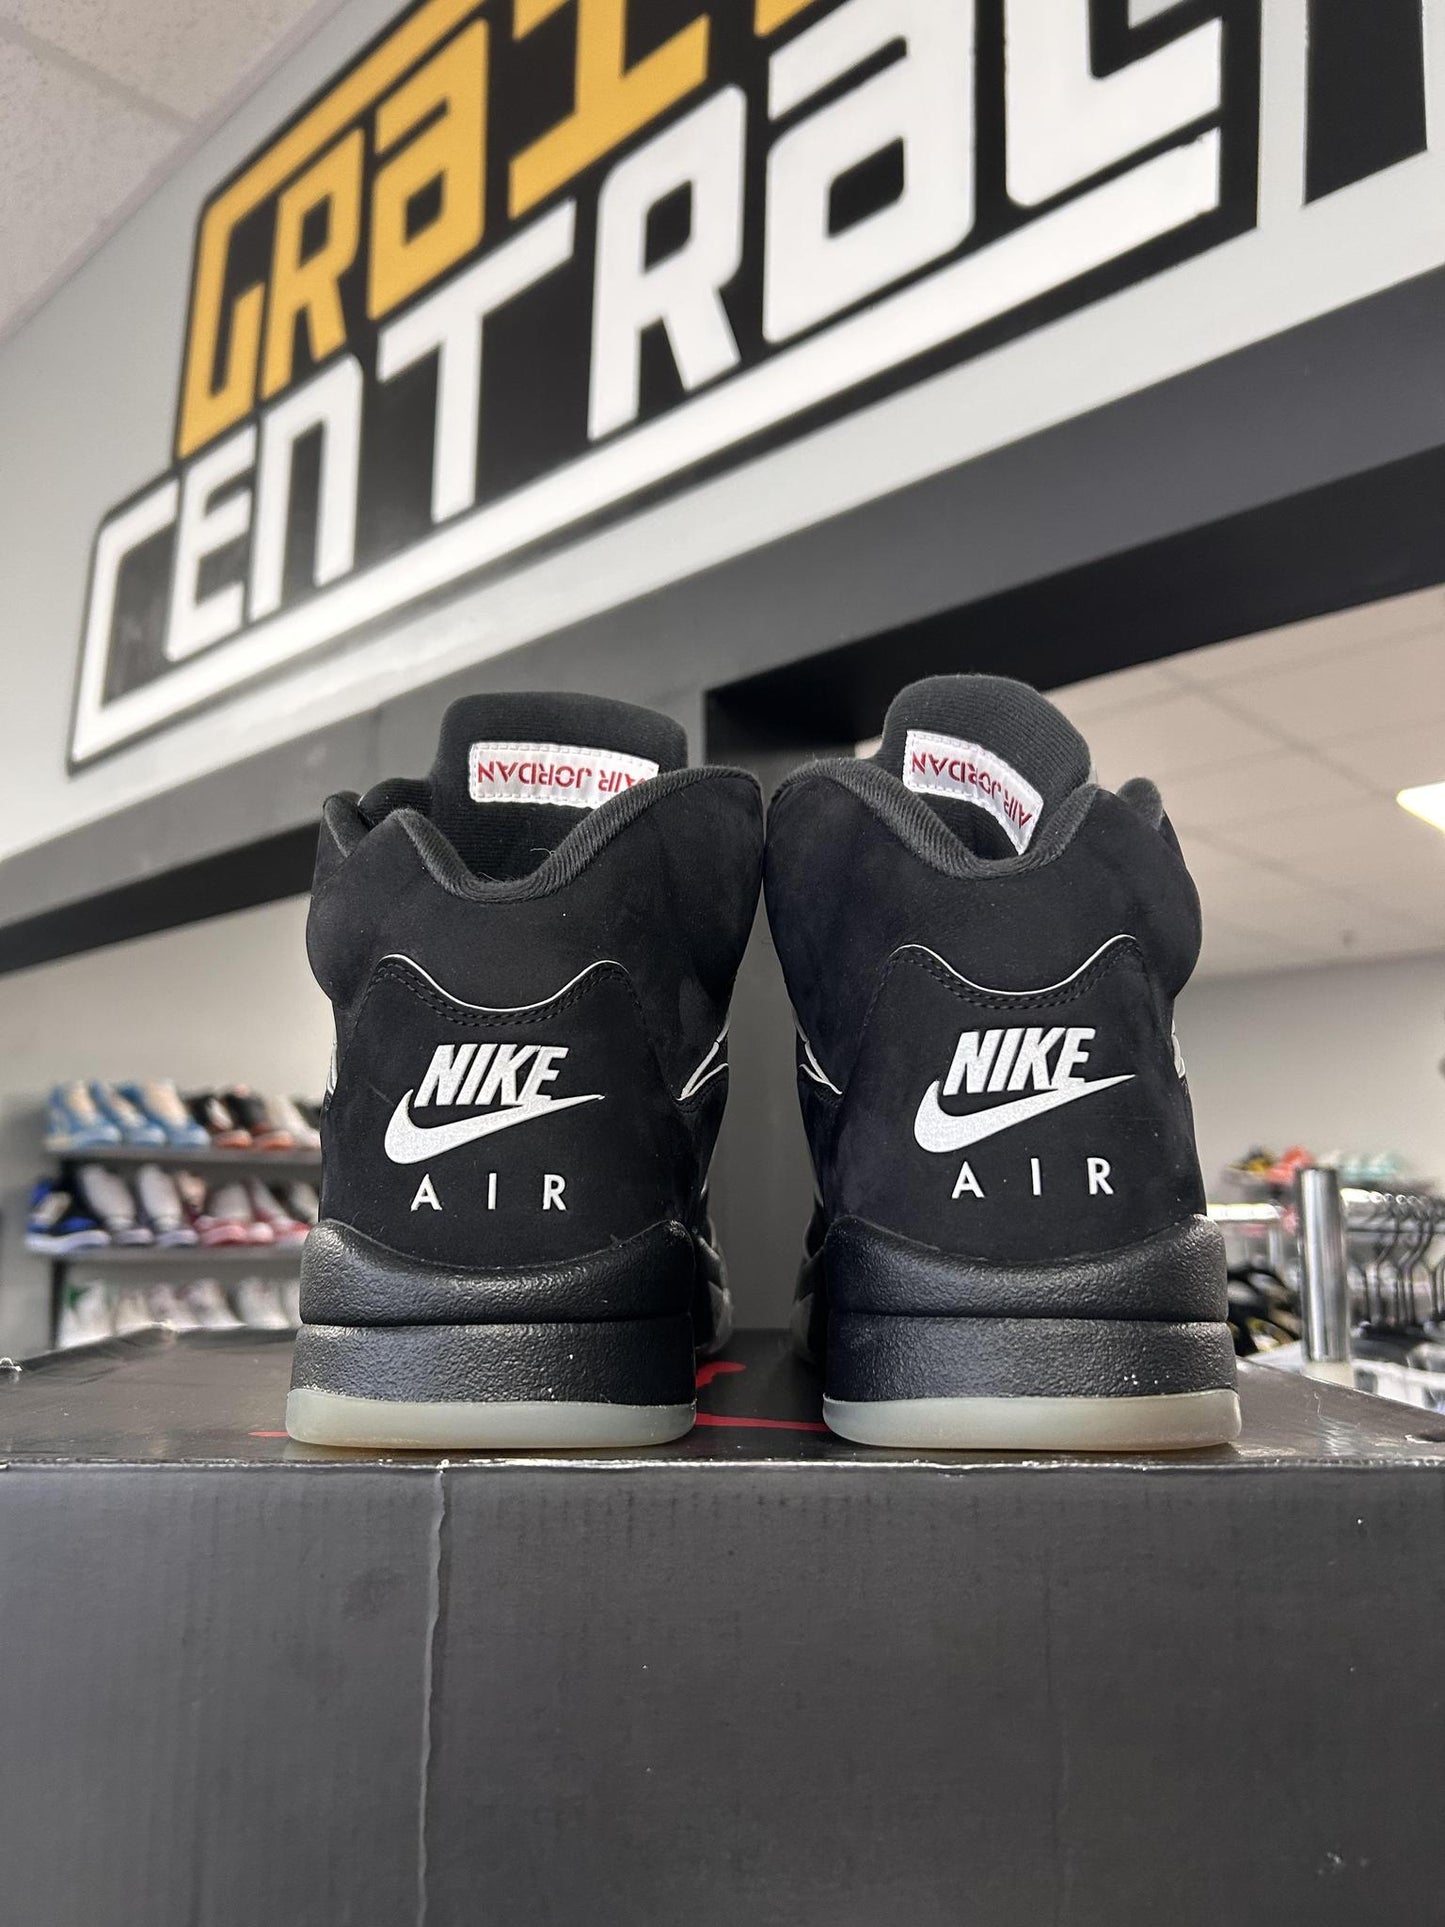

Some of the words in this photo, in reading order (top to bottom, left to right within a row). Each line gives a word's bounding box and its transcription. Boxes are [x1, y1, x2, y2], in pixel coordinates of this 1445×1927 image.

[477, 761, 592, 788] JORDAN
[911, 751, 1001, 799] JORDAN
[1003, 789, 1033, 829] AIR
[413, 1043, 570, 1108] NIKE
[942, 1027, 1098, 1096] NIKE
[410, 1173, 567, 1212] AIR
[951, 1157, 1114, 1199] AIR
